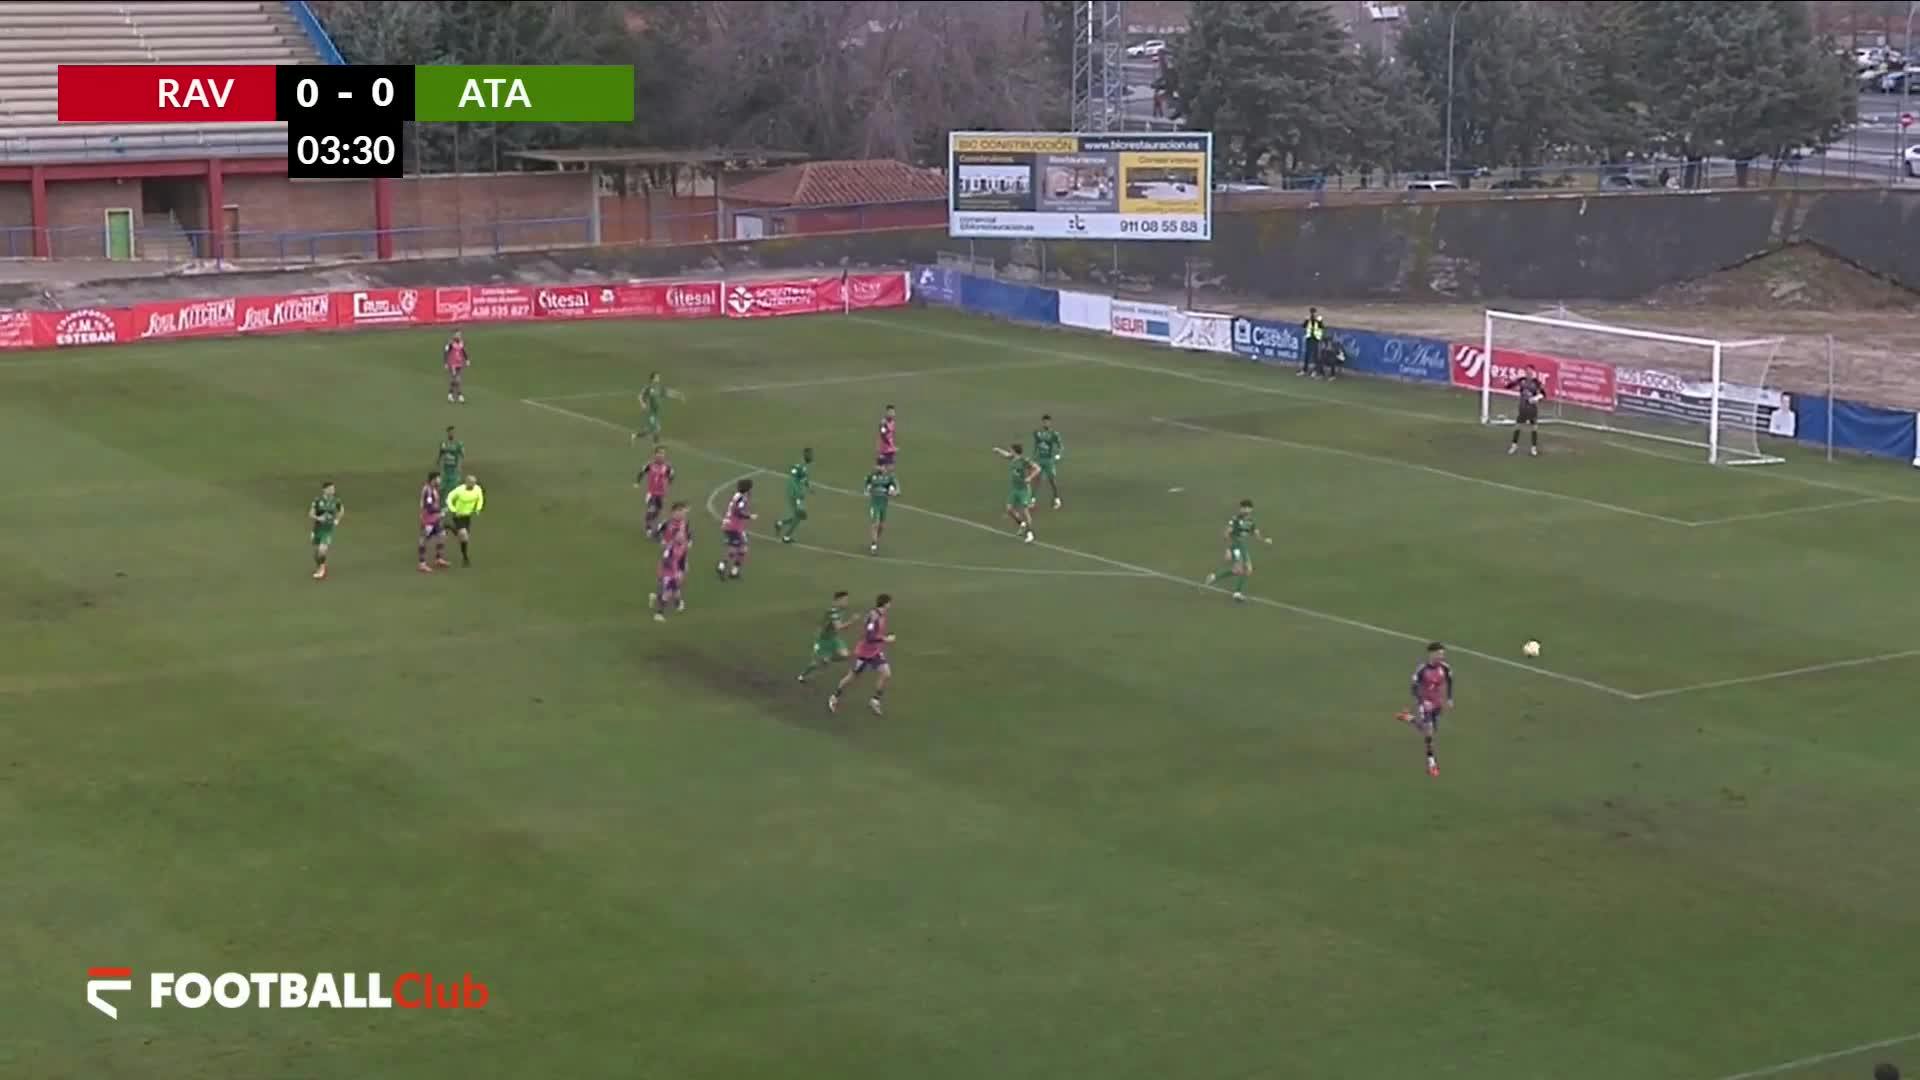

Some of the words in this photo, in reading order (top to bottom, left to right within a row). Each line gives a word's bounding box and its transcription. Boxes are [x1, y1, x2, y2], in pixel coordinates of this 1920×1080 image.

[1120, 220, 1138, 232] 911
[1141, 220, 1158, 232] 08
[1161, 220, 1178, 232] 55
[1180, 221, 1197, 232] 88
[538, 290, 588, 308] Citesal
[666, 287, 715, 306] Citesal
[177, 298, 236, 331] KITCHEN
[273, 293, 329, 325] KITCHEN
[1114, 315, 1145, 334] SEUR
[56, 332, 116, 345] ESTEBAN
